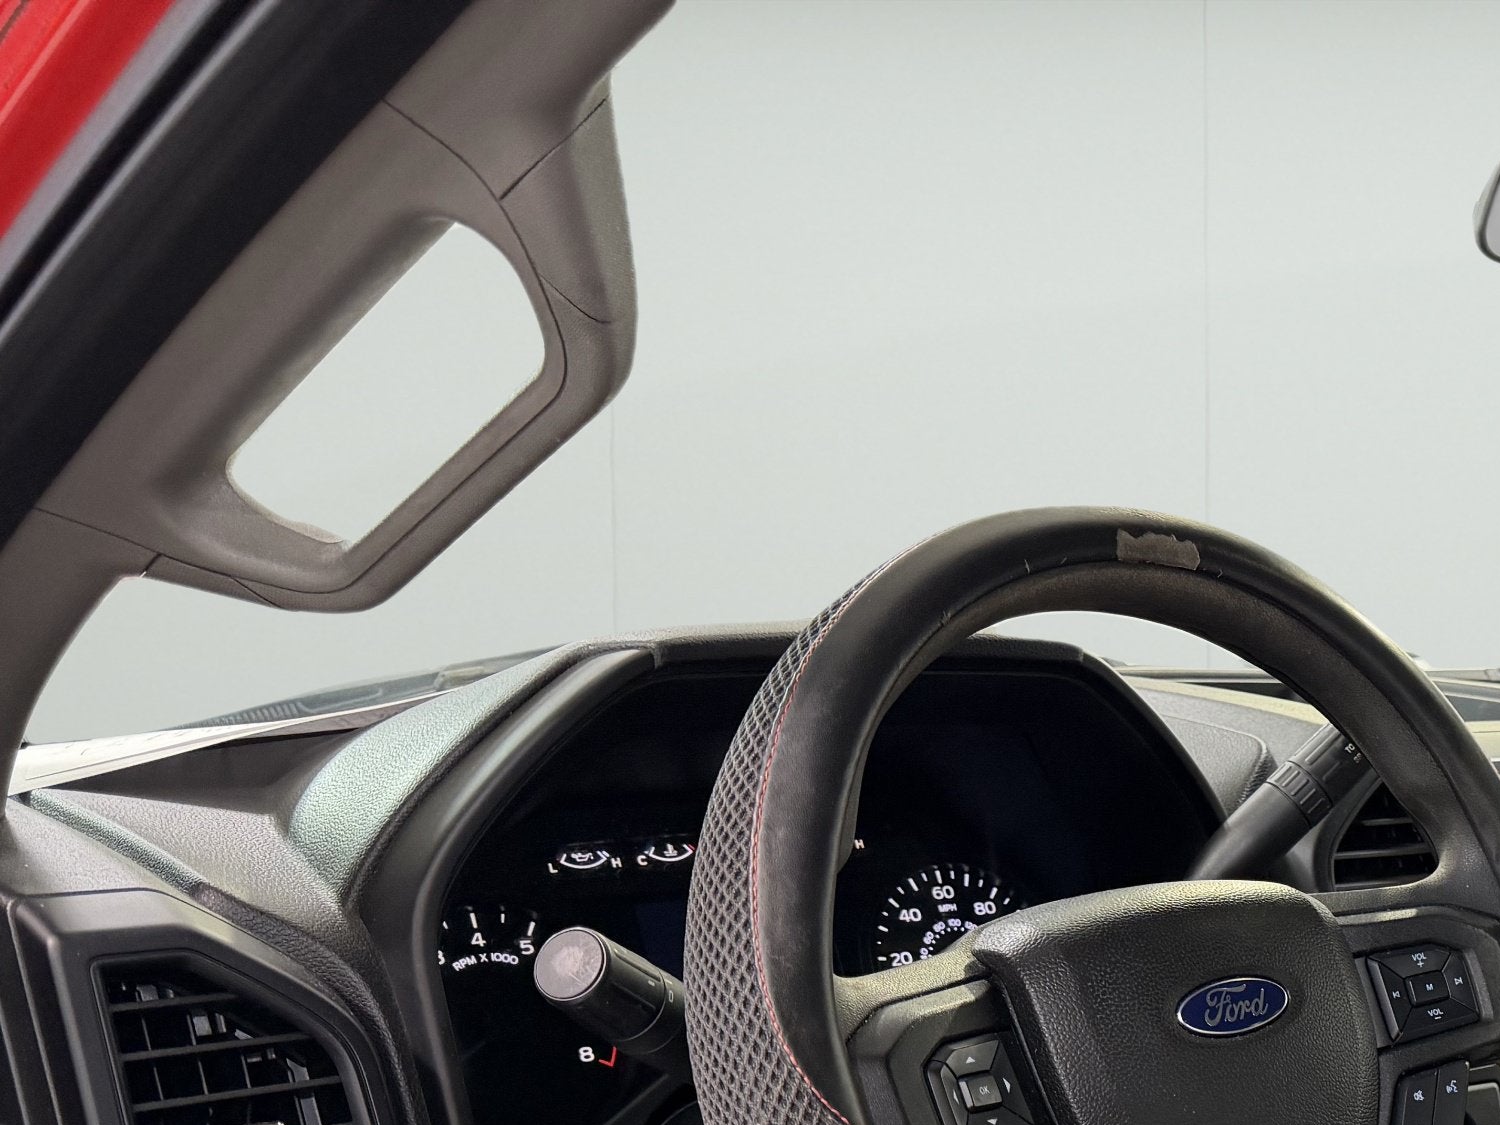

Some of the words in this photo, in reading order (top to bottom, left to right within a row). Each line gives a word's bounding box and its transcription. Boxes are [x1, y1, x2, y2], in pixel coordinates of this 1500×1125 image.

[612, 857, 622, 868] H
[636, 854, 648, 866] C
[548, 862, 558, 874] L
[932, 885, 955, 900] 60
[899, 908, 922, 923] 40
[938, 903, 957, 914] MPH
[973, 901, 996, 916] 80
[471, 932, 487, 947] 4
[519, 940, 535, 955] 5
[452, 955, 477, 972] RPM
[490, 952, 519, 965] 1000
[891, 951, 913, 966] 20
[1411, 952, 1427, 961] VOL
[1425, 983, 1433, 991] M
[1204, 983, 1269, 1027] Ford
[1427, 1008, 1444, 1017] VOL
[579, 1046, 595, 1063] 8
[979, 1085, 990, 1095] OK
